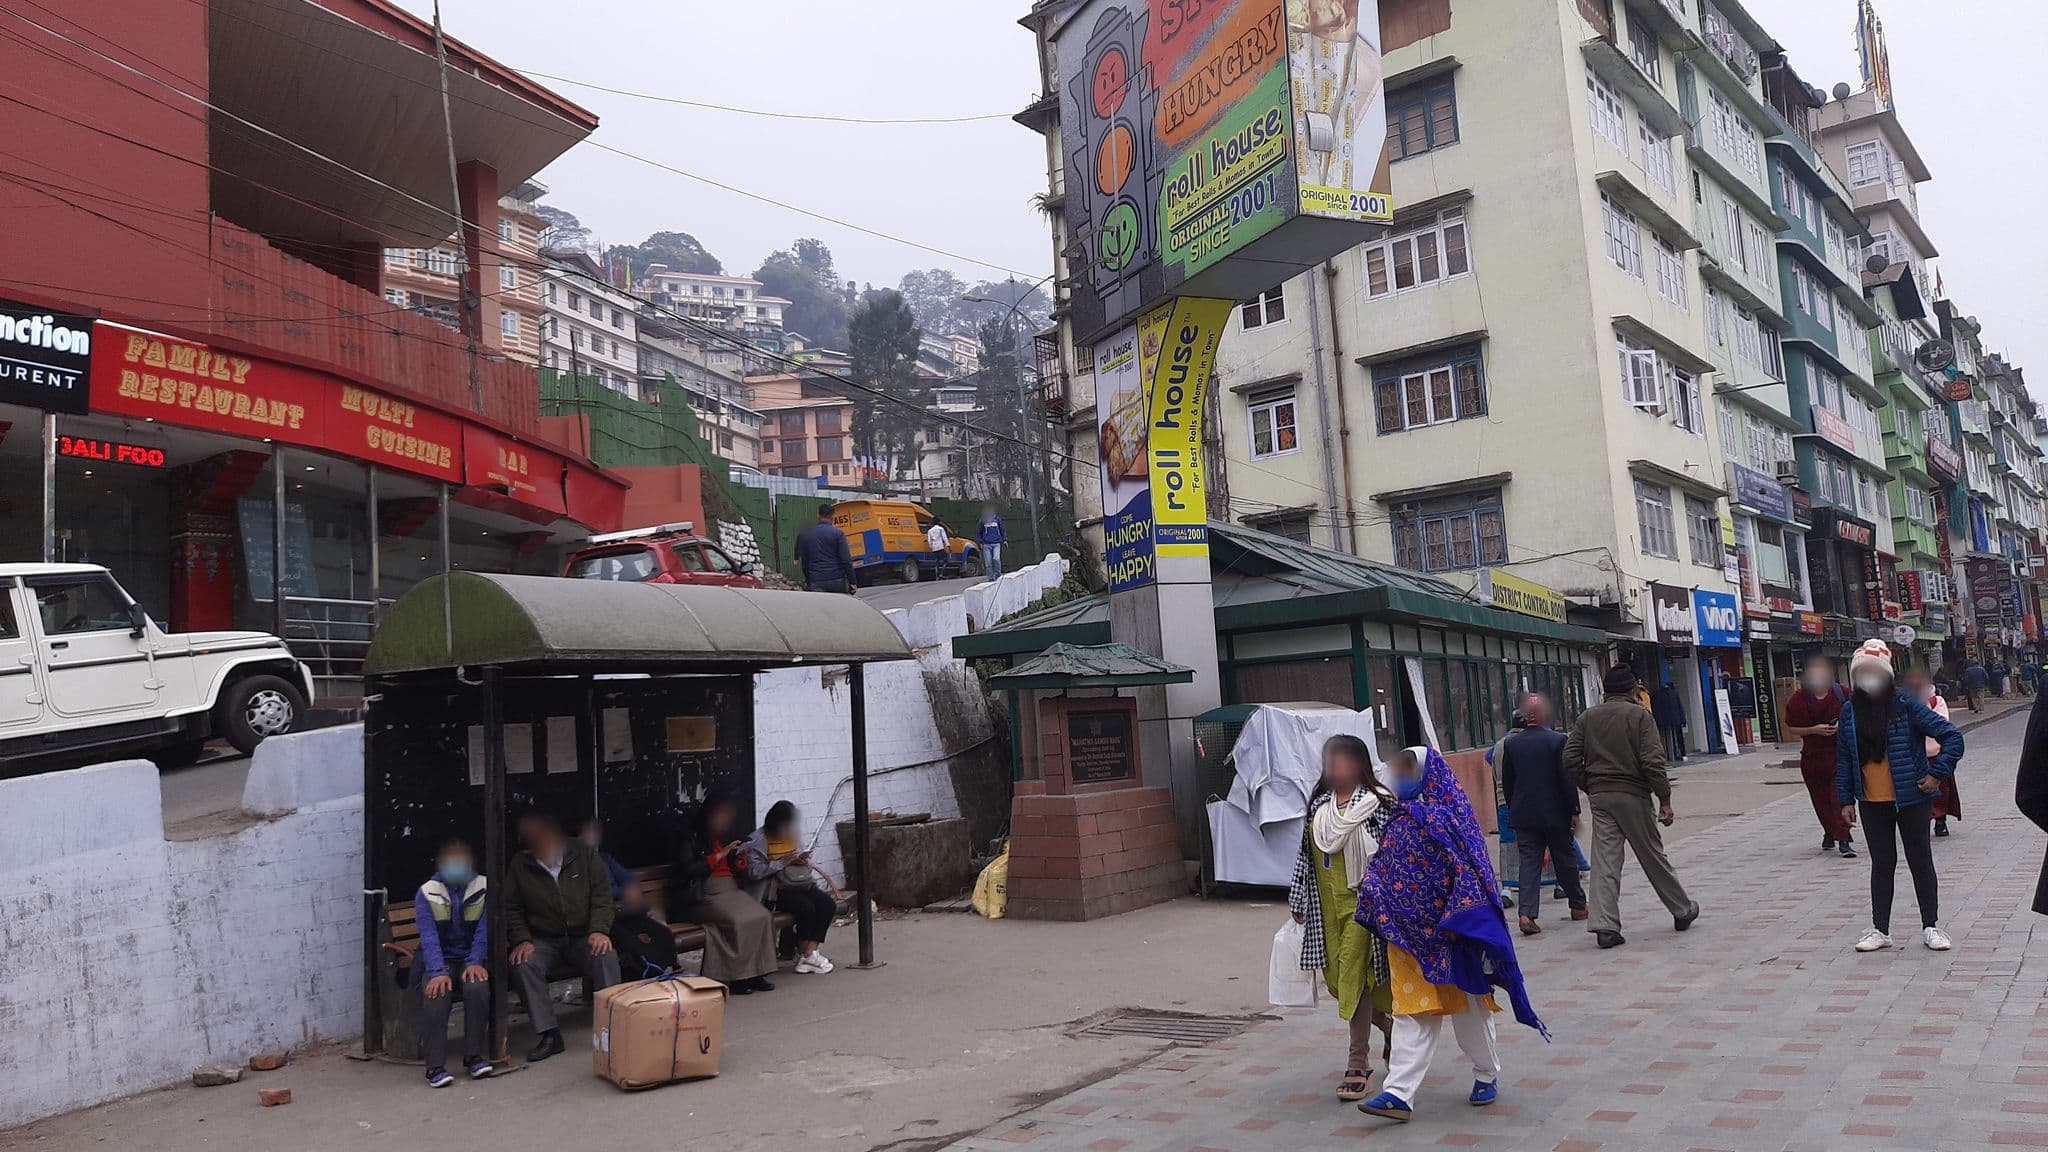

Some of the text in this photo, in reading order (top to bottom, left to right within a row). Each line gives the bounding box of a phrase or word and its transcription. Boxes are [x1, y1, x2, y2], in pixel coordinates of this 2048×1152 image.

[1163, 5, 1280, 134] HUNGRY
[1167, 107, 1283, 209] roll house
[1187, 199, 1200, 212] Best
[1202, 187, 1217, 203] Rolls
[1225, 168, 1247, 186] Momos
[1301, 189, 1387, 214] ORIGINAL 2001
[1327, 201, 1347, 210] since
[1170, 172, 1276, 252] ORIGINAL 2001
[1191, 225, 1231, 262] SINCE
[124, 335, 251, 384] FAMILY
[1100, 347, 1111, 366] roll
[1113, 341, 1132, 358] house
[1198, 360, 1207, 369] in
[1156, 323, 1199, 429] house
[1191, 372, 1204, 404] Momos
[118, 370, 304, 429] RESTAURANT
[341, 386, 415, 428] MULTI
[367, 425, 451, 469] CUISINE
[1189, 420, 1197, 442] Rolls
[1190, 447, 1198, 468] Best
[1156, 450, 1186, 511] roll
[1106, 519, 1151, 550] HUNGRY
[1188, 529, 1205, 540] 2001
[1109, 553, 1152, 586] HAPPY
[1492, 582, 1521, 610] DISTRICT
[1523, 592, 1551, 616] CONTROL
